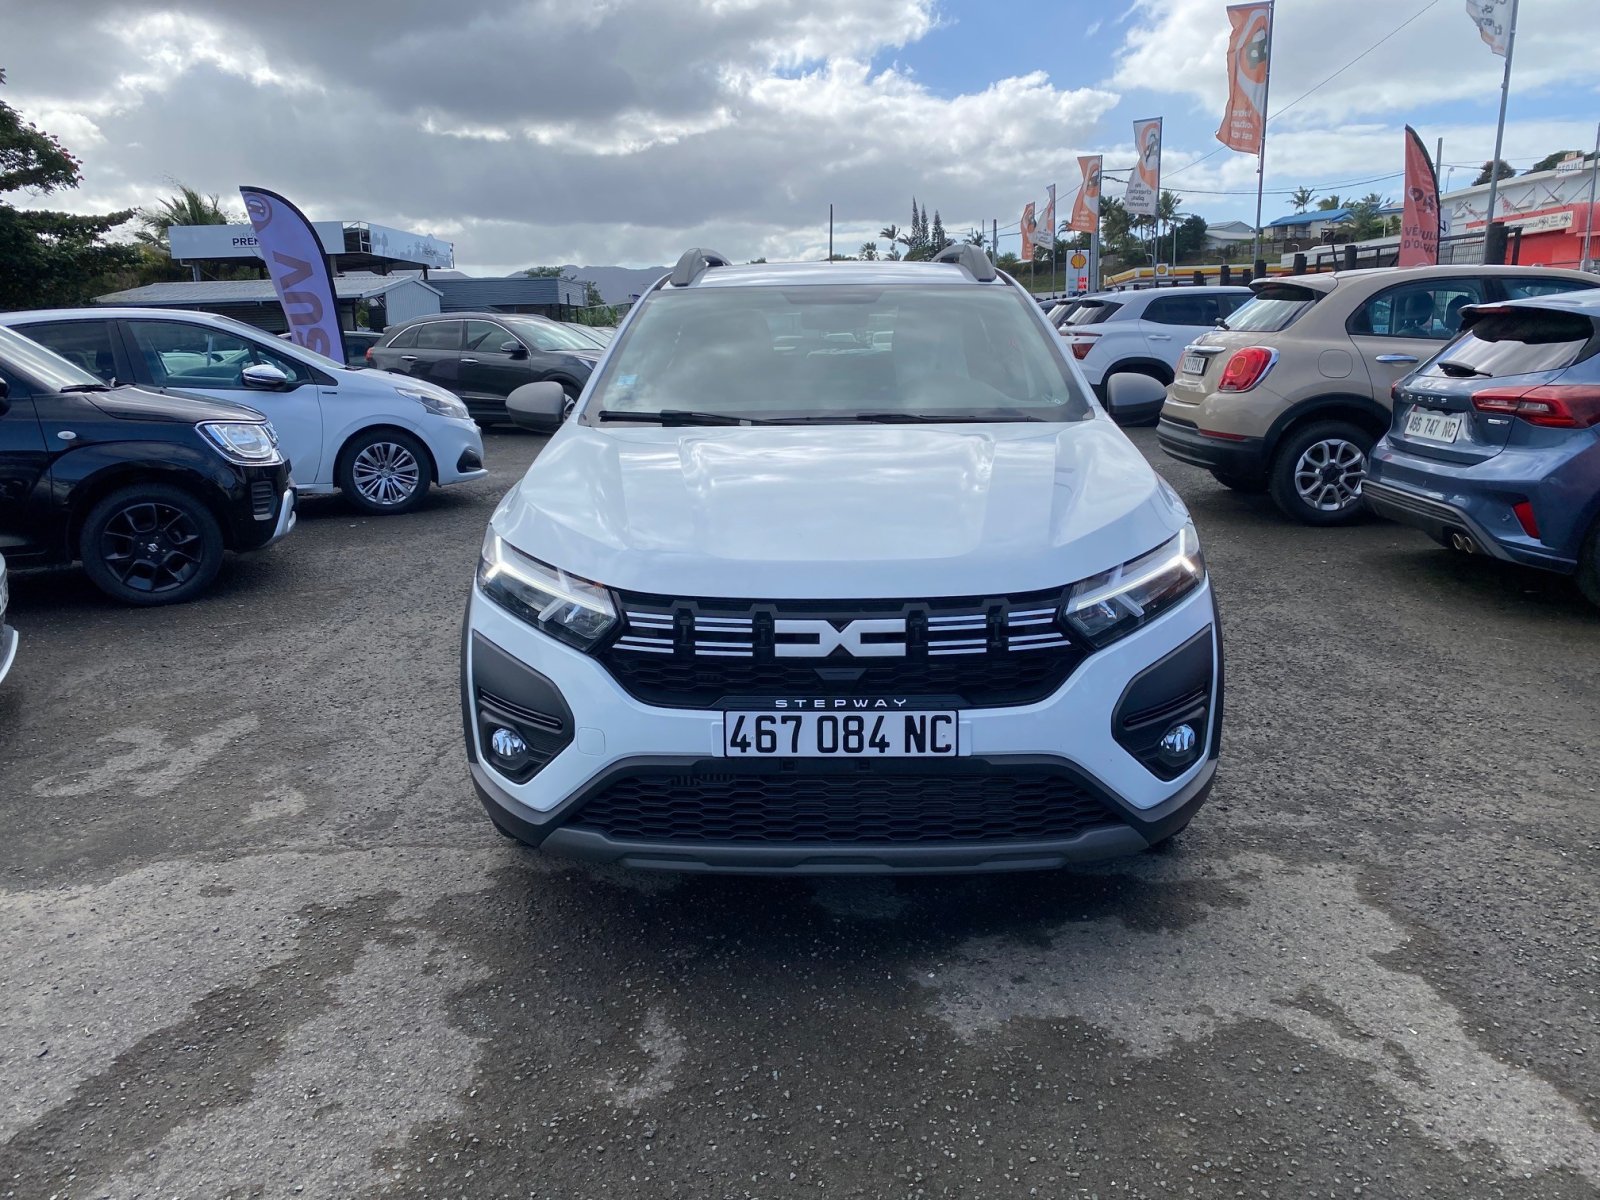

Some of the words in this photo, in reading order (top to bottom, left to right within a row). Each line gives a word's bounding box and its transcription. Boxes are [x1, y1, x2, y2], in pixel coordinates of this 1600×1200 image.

[271, 250, 331, 358] SUV
[1423, 418, 1440, 436] 747
[1441, 421, 1457, 438] NC
[775, 699, 907, 708] STEPWAY
[729, 715, 803, 753] 467
[816, 715, 890, 753] 084
[904, 715, 952, 753] NC
